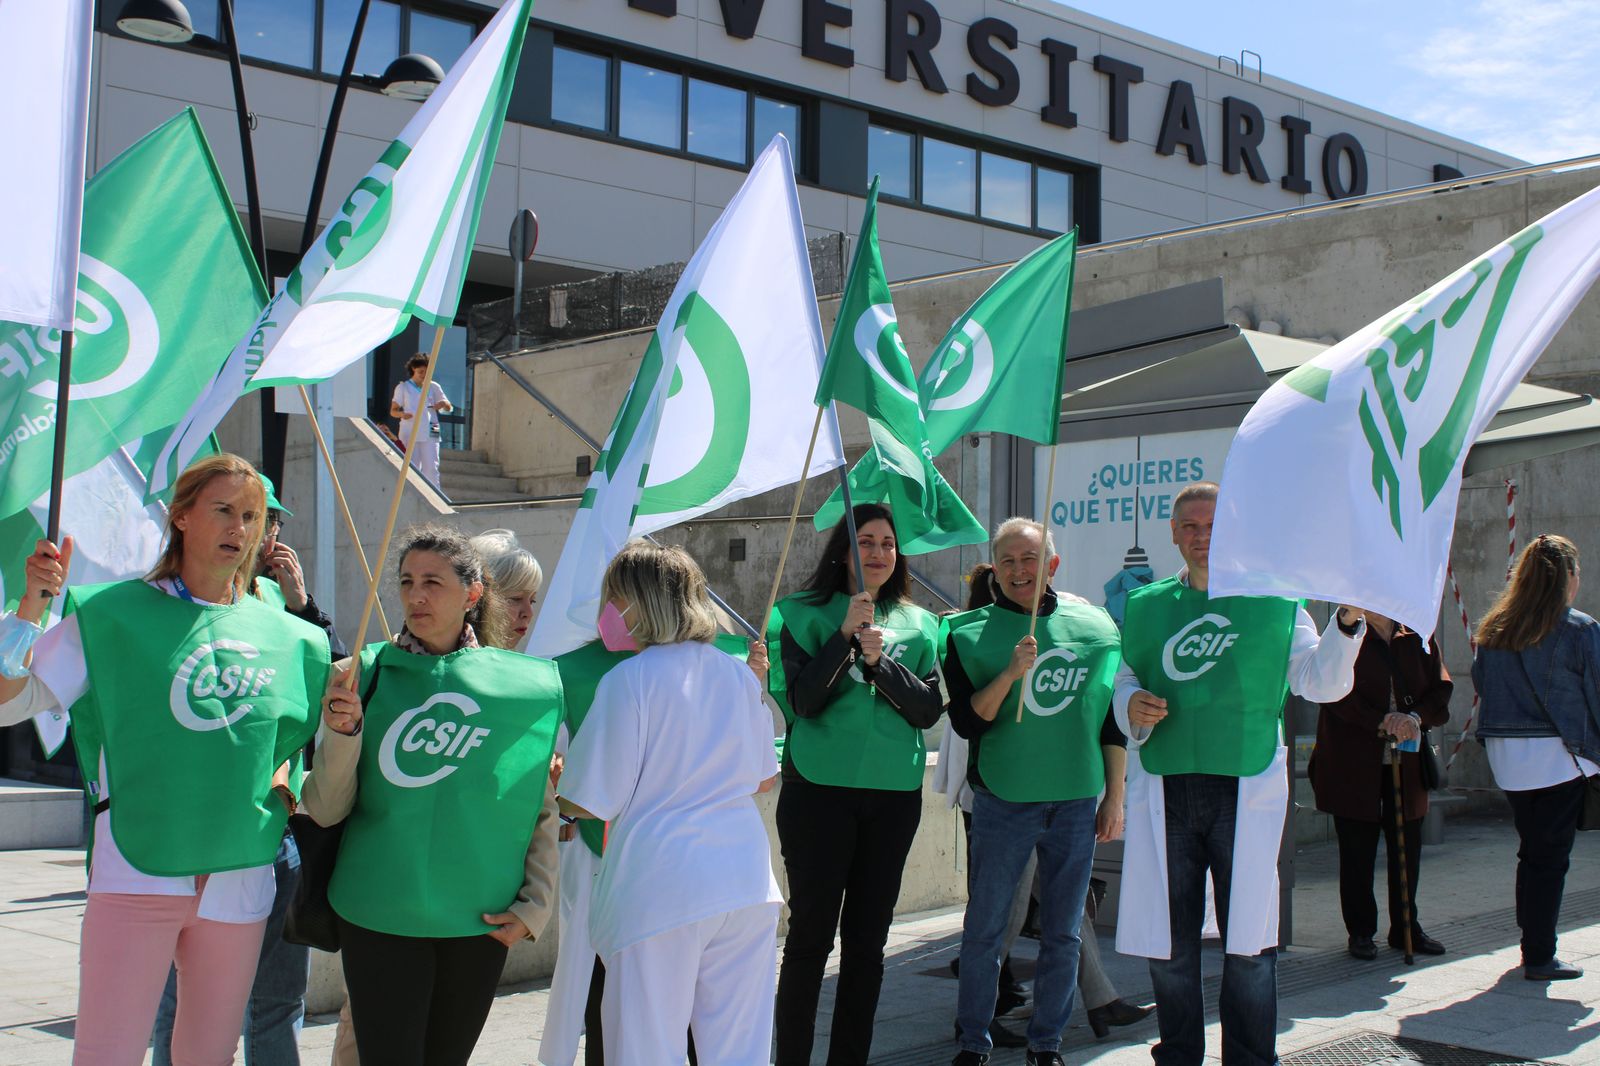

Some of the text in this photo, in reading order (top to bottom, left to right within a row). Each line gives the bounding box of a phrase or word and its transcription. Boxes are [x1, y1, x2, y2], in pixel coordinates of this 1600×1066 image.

[628, 0, 1368, 206] ERSITARIO
[1088, 457, 1204, 496] ¿QUIERES
[1051, 494, 1171, 528] QUE TE VE
[1176, 632, 1240, 658] CSIF
[193, 664, 276, 698] CSIF
[1035, 667, 1089, 693] CSIF
[402, 718, 491, 759] CSIF
